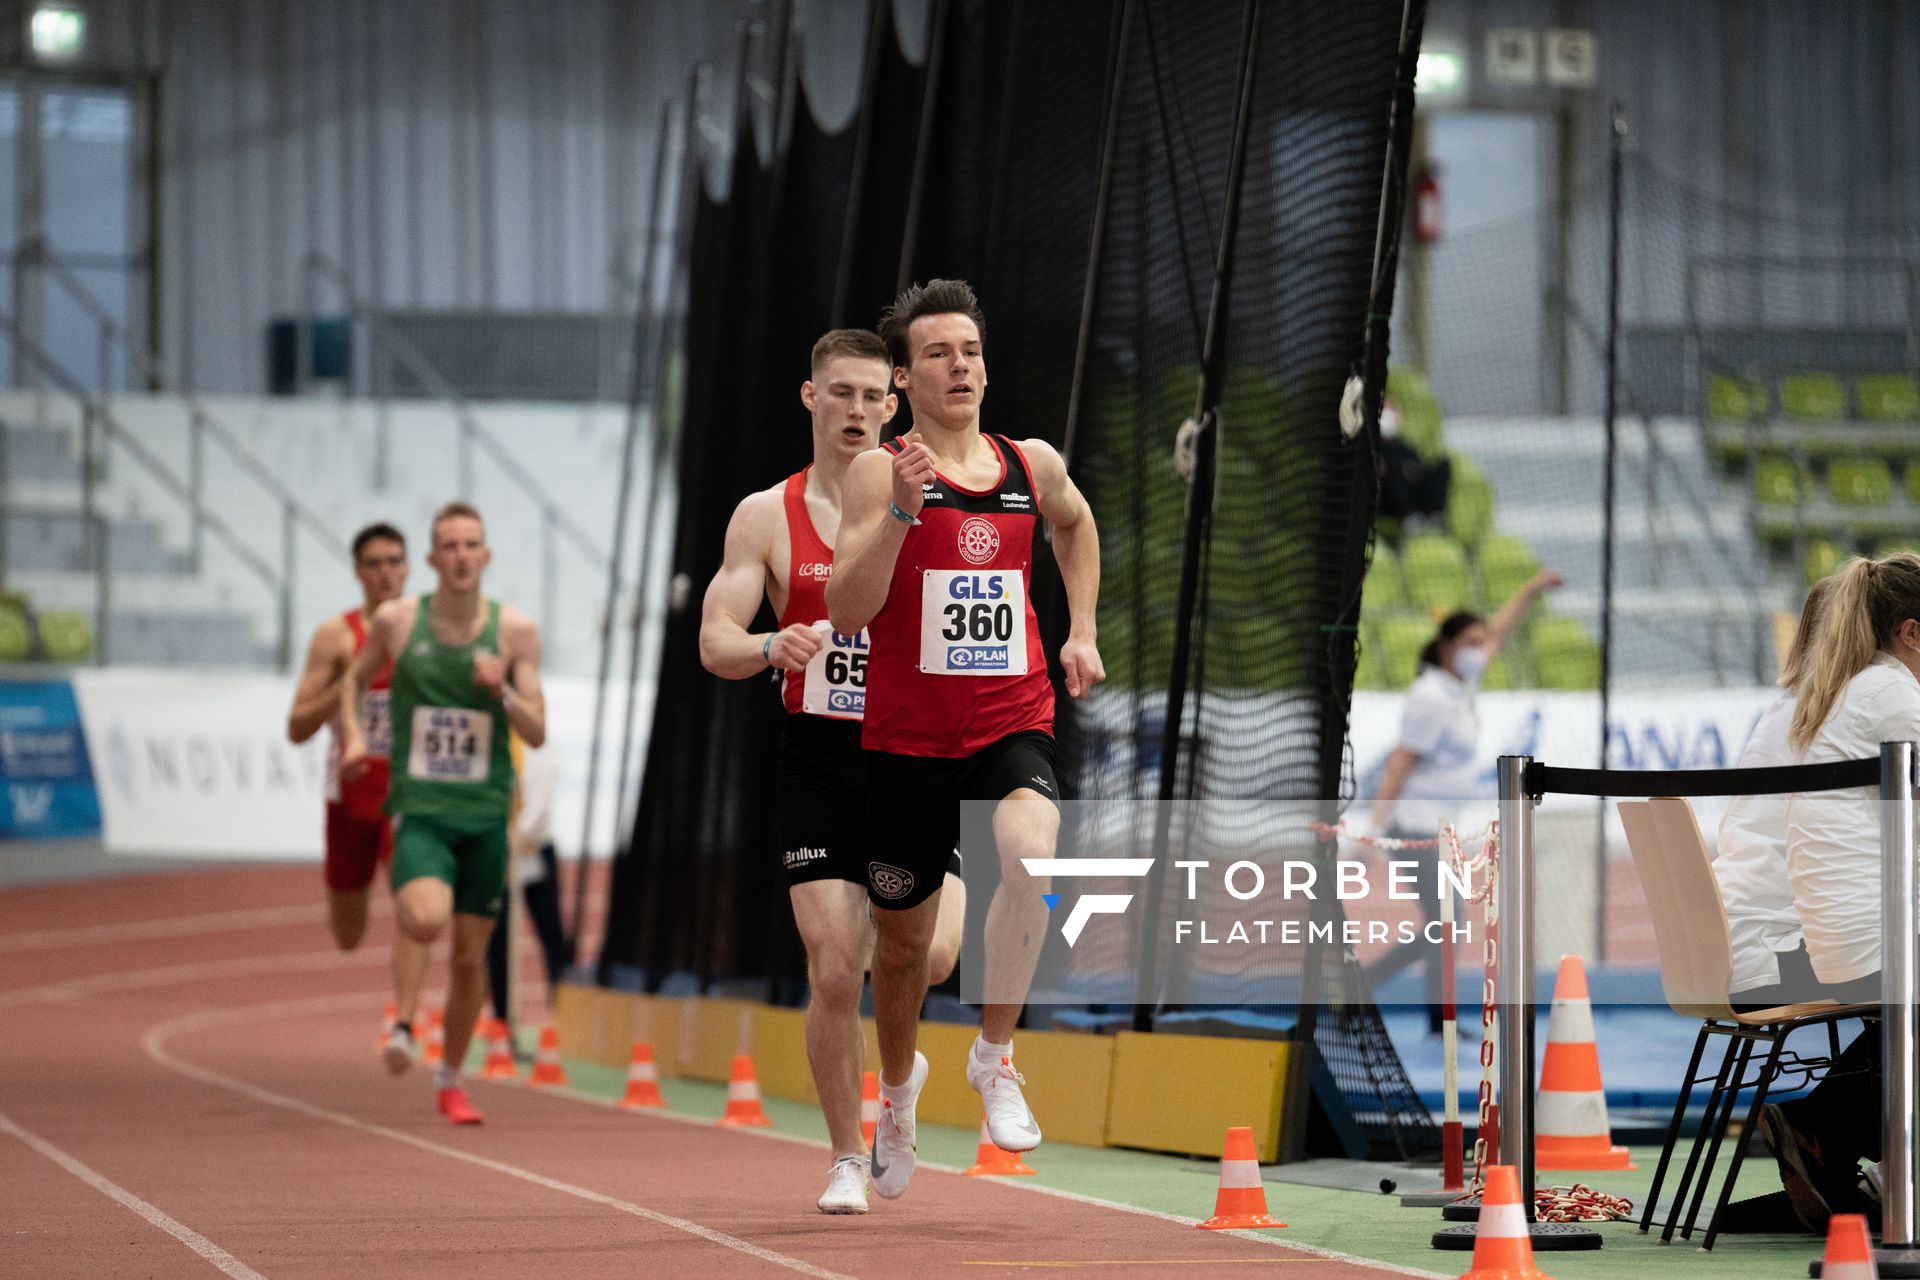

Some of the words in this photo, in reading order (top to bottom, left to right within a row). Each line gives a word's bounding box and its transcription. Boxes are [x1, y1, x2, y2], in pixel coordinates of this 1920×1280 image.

[941, 603, 1013, 642] 360
[831, 629, 868, 650] GL
[825, 650, 868, 688] 65
[974, 650, 1007, 661] PLAN
[425, 729, 476, 758] 514
